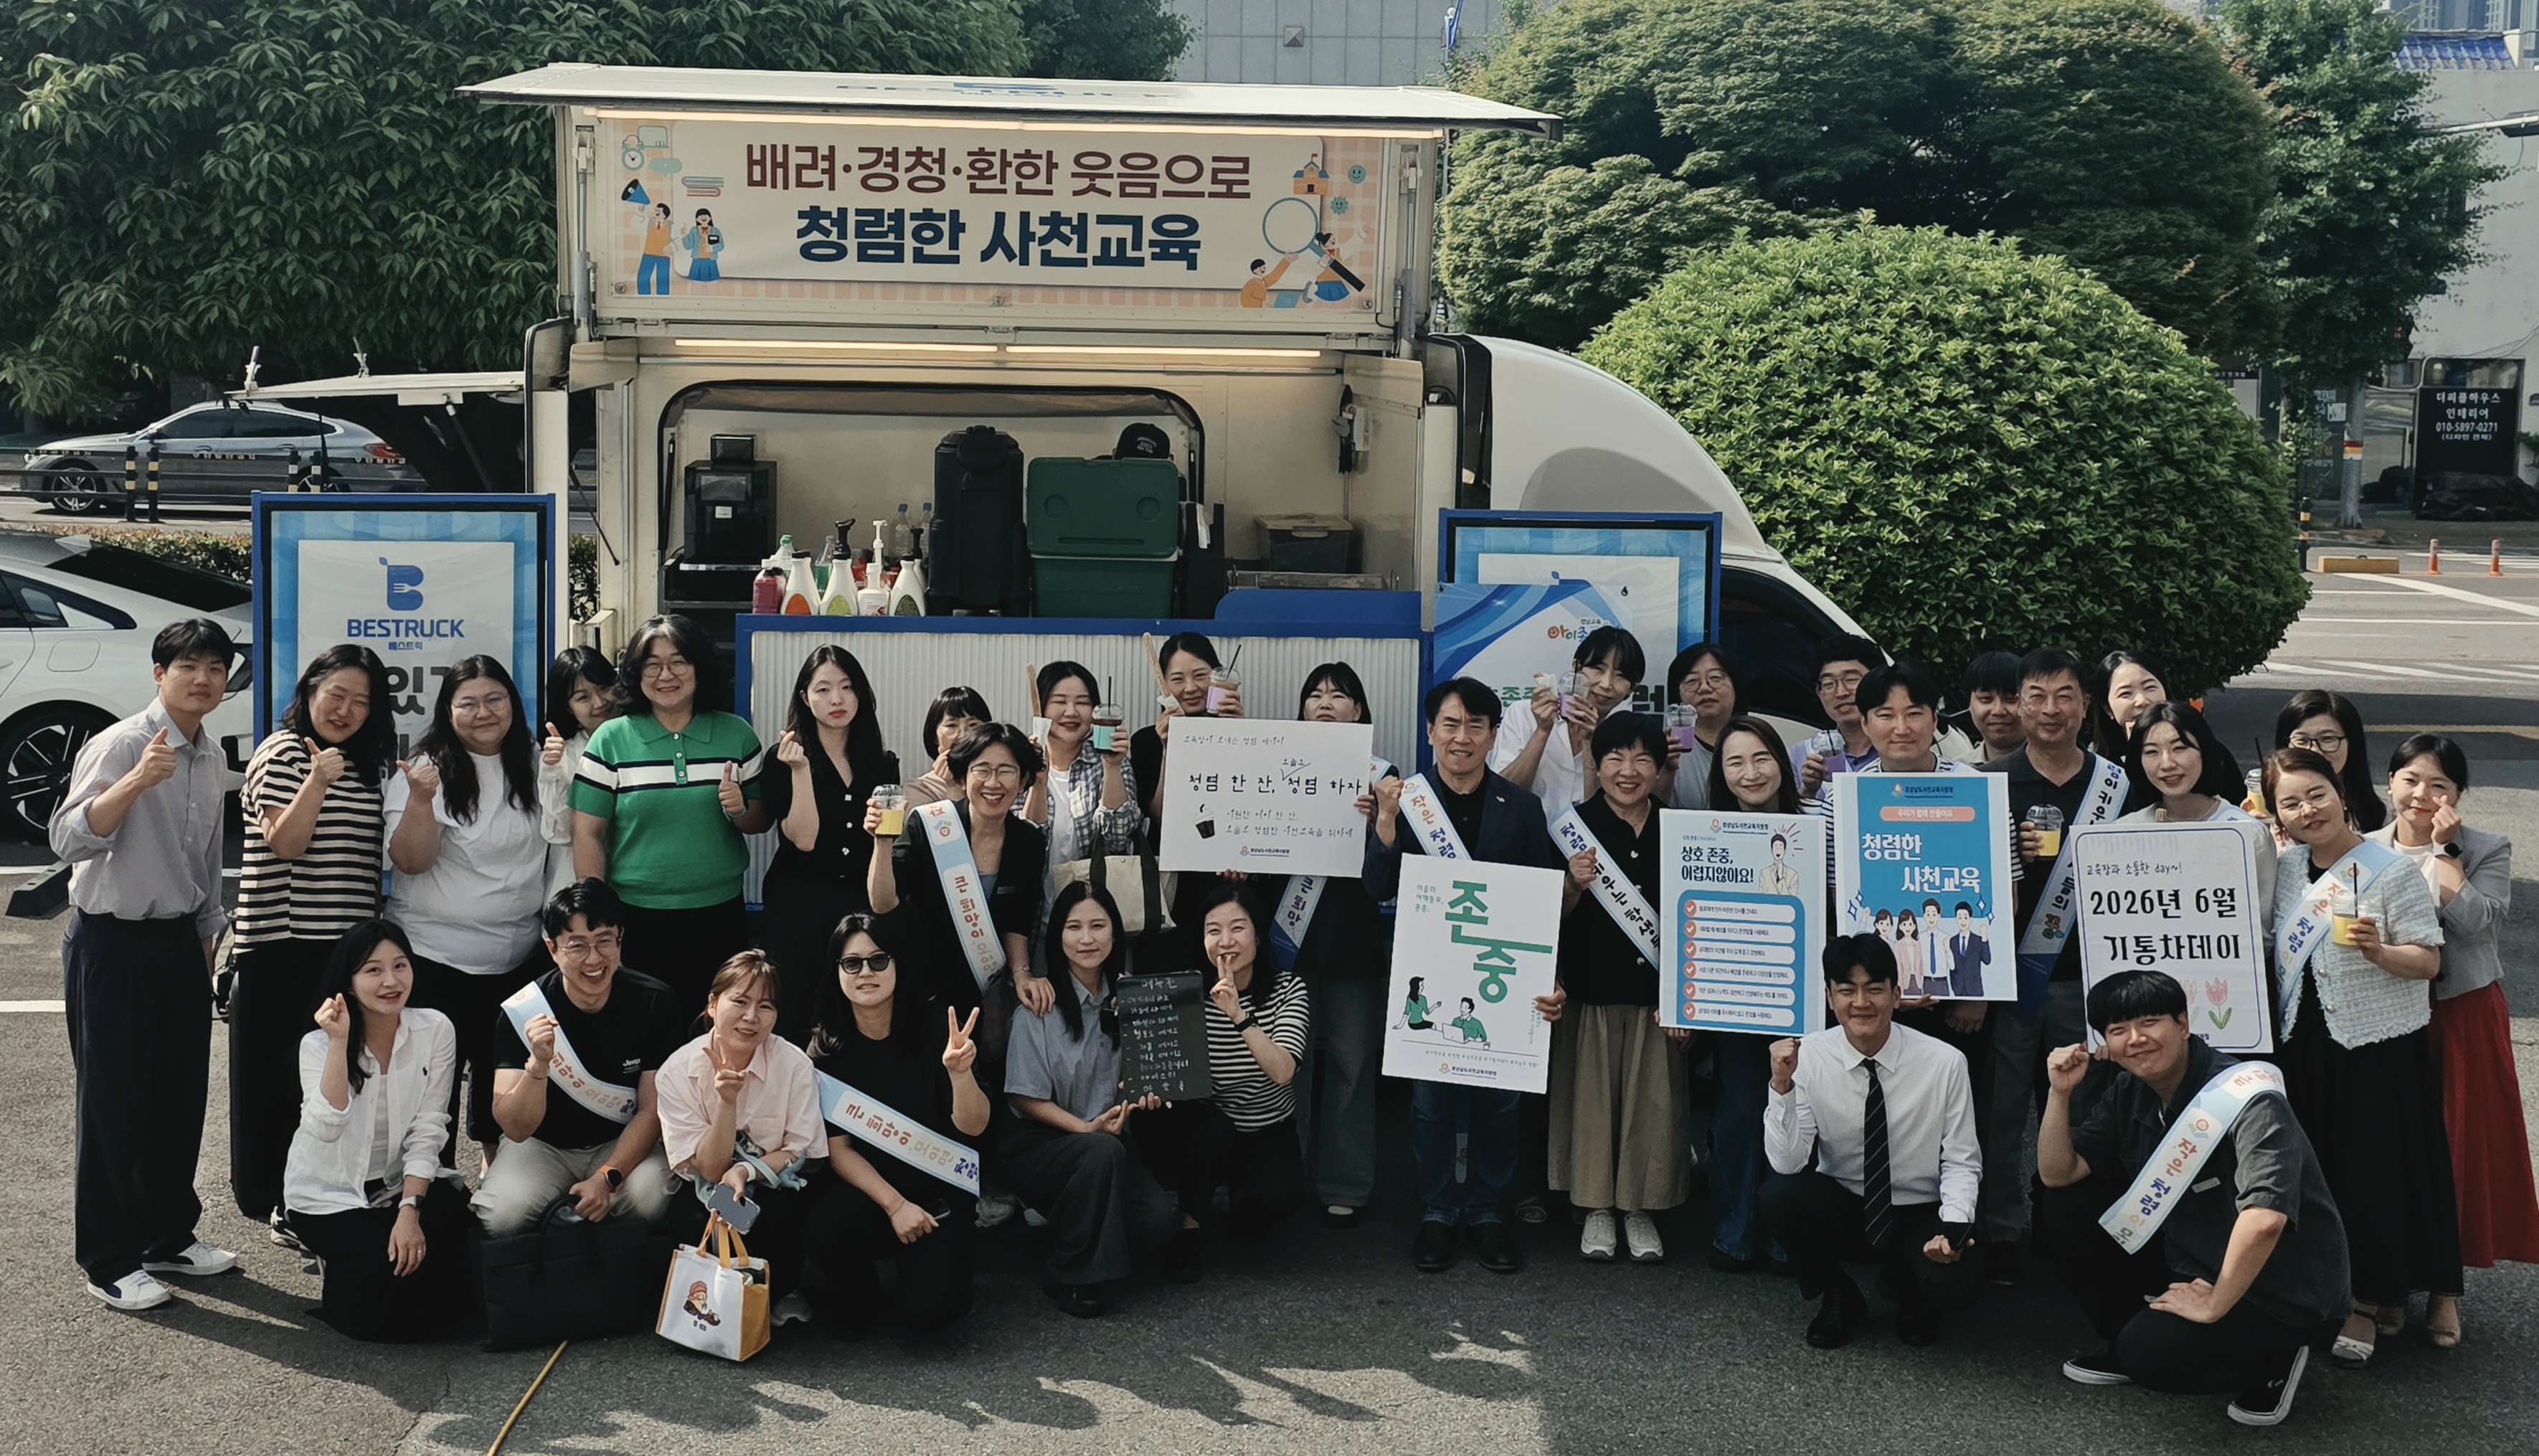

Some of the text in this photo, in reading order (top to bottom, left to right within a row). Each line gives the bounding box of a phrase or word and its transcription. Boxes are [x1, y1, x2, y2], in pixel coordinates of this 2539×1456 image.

[747, 143, 1251, 199] 배려·경청·환한 웃음으로
[798, 206, 1201, 270] 청렴한 사천교육
[2436, 422, 2498, 432] 010-5897-0271
[2446, 407, 2490, 419] 인테리어
[347, 618, 465, 638] BESTRUCK
[388, 641, 423, 651] 베스트럭
[1189, 774, 1362, 795] 청렴 한 잔, 청렴 하자
[2090, 790, 2113, 825] 키우
[1410, 795, 1457, 859] 작은 청렴
[1681, 846, 1733, 864] 상호 존중,
[1862, 833, 1922, 861] 청렴한
[1901, 865, 1981, 894] 사천교육
[2086, 864, 2121, 876] 교육장과
[2125, 861, 2150, 876] 소통한
[955, 875, 969, 894] 큰
[1287, 897, 1307, 926] 희망
[2091, 887, 2238, 919] 2026년 6월
[960, 898, 985, 938] 희망이
[1445, 880, 1553, 1003] 존중
[2103, 934, 2242, 966] 기통차데이
[623, 1058, 641, 1067] Jeep
[1140, 1071, 1176, 1081] 아이스티
[846, 1103, 864, 1119] 큰
[866, 1114, 912, 1145] 희망이
[913, 1140, 954, 1166] 모이면
[2165, 1138, 2198, 1177] 작은
[2128, 1177, 2172, 1227] 청렴이
